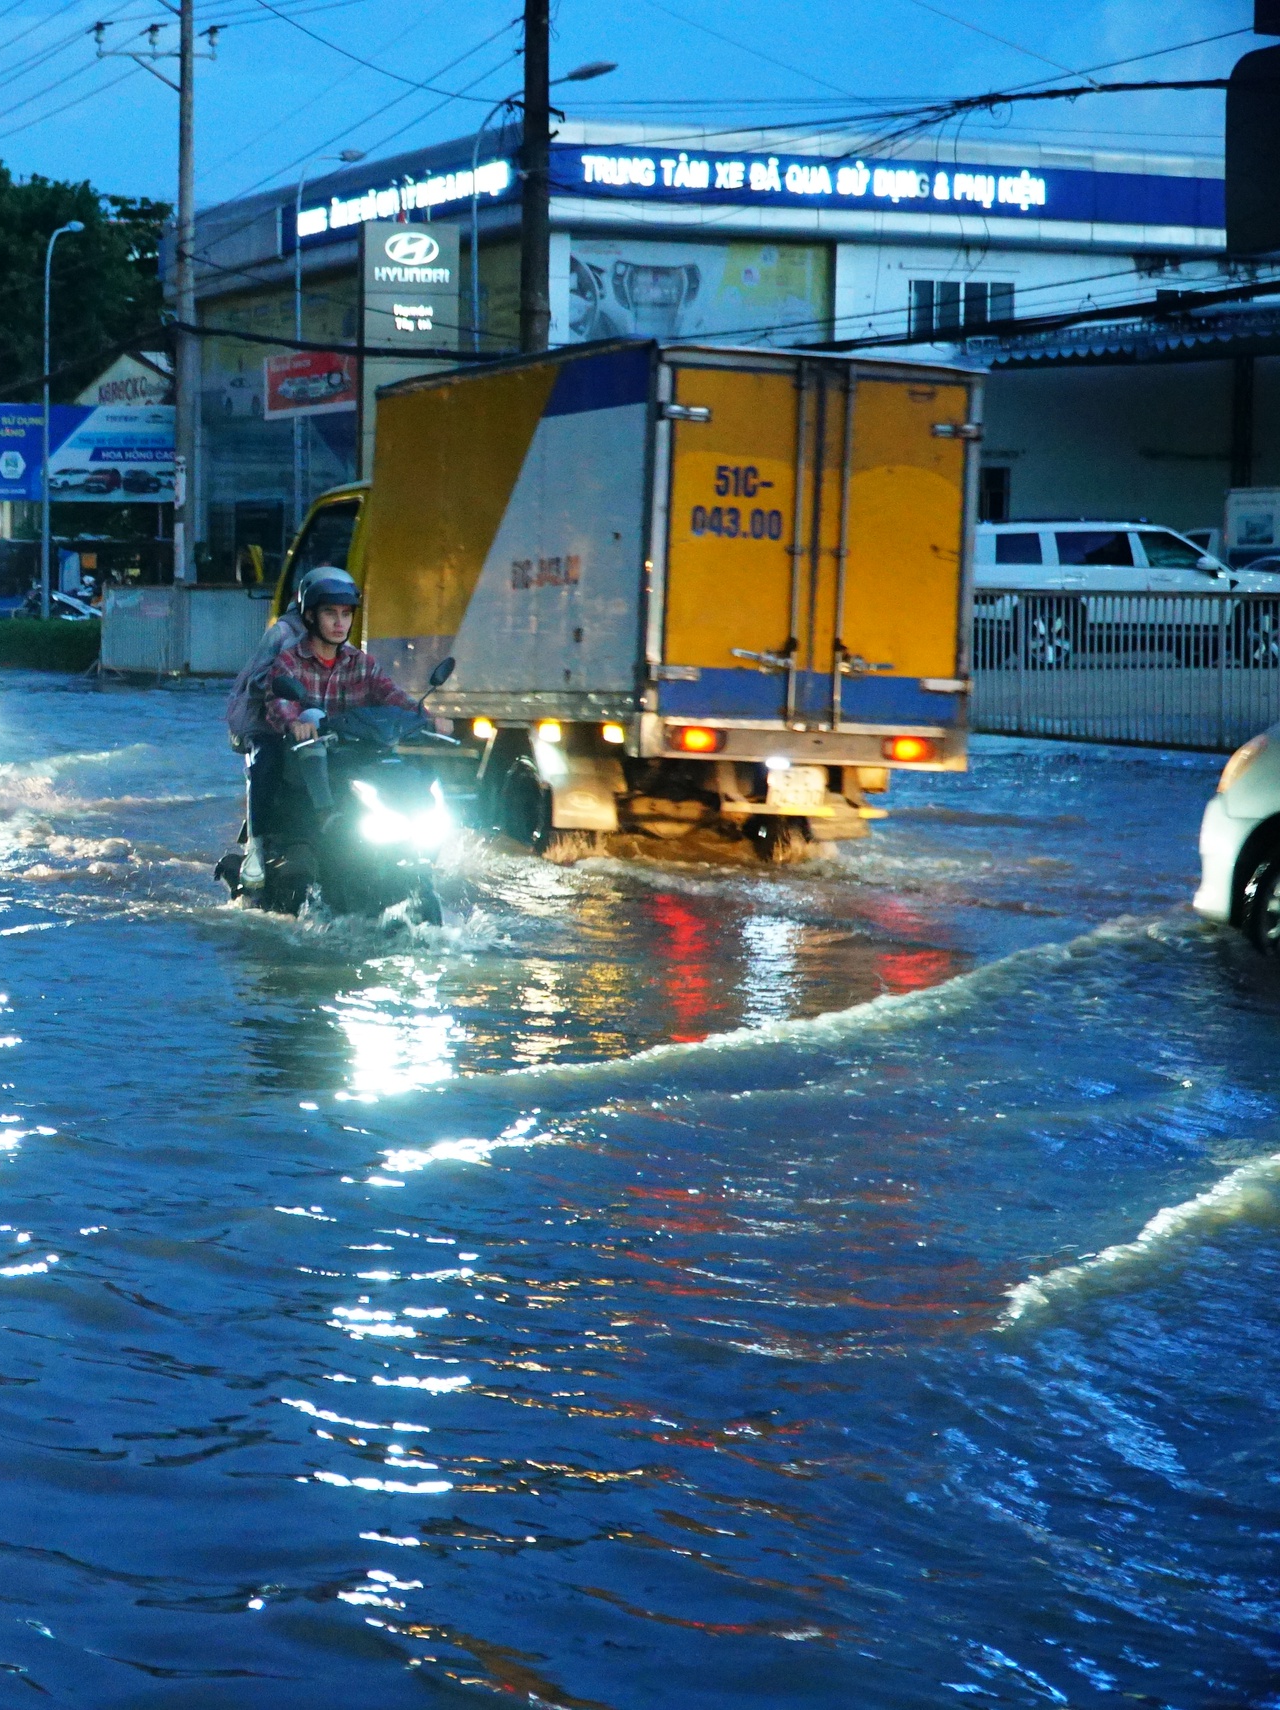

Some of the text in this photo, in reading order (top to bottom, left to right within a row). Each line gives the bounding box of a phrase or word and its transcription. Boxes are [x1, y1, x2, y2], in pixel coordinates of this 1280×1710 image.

[581, 155, 655, 187] TRUNG
[660, 152, 710, 189] TÂM
[715, 161, 746, 190] XE
[785, 164, 832, 194] QUA
[933, 172, 950, 200] &
[953, 173, 995, 209] PHỤ
[374, 266, 450, 283] HYUNDAI
[715, 465, 775, 498] 51C-
[691, 505, 783, 541] 043.00
